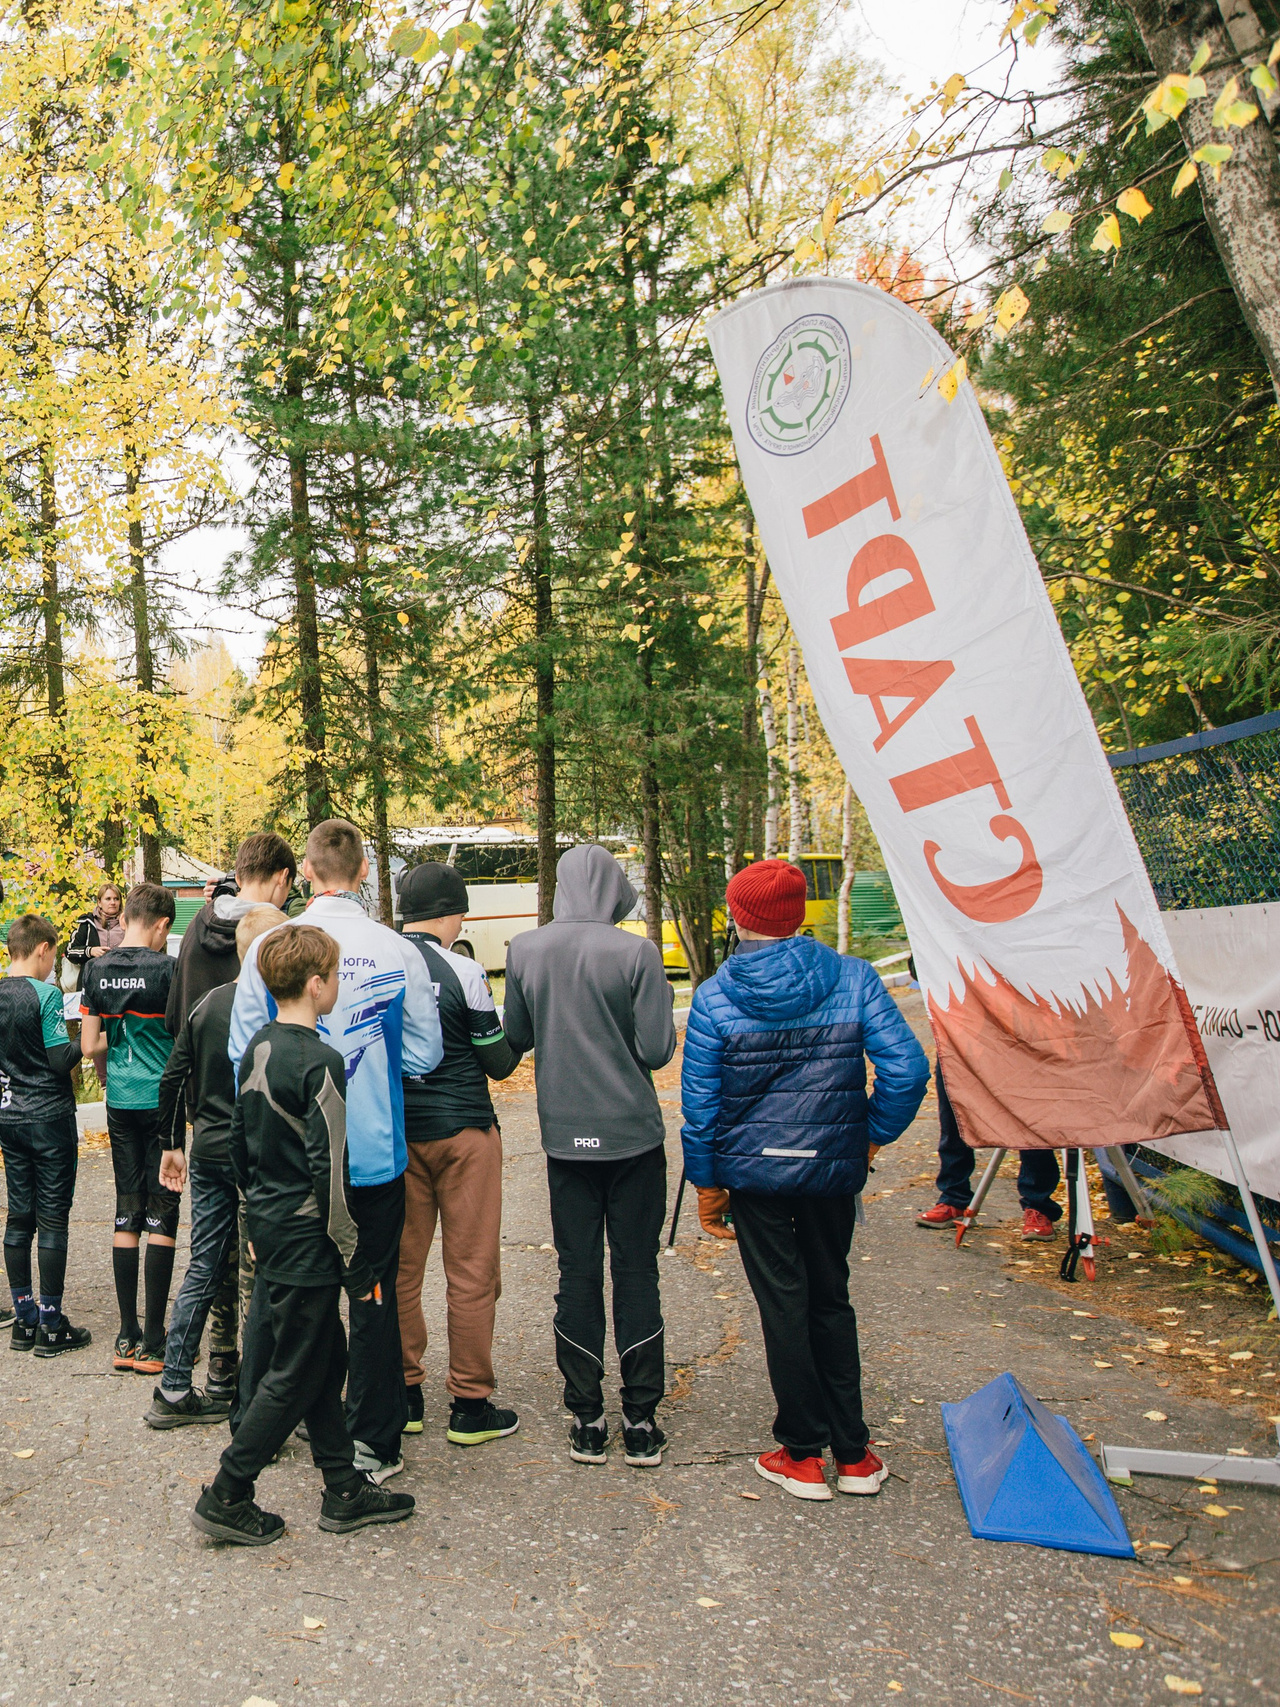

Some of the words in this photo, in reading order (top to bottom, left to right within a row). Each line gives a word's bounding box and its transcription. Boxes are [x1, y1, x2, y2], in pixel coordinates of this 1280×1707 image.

[343, 957, 376, 969] ЮГРА
[100, 978, 146, 989] O-UGRA
[1200, 1006, 1243, 1038] ХМАО
[574, 1138, 600, 1148] PRO
[17, 1294, 33, 1304] FIL
[40, 1303, 56, 1311] ILA
